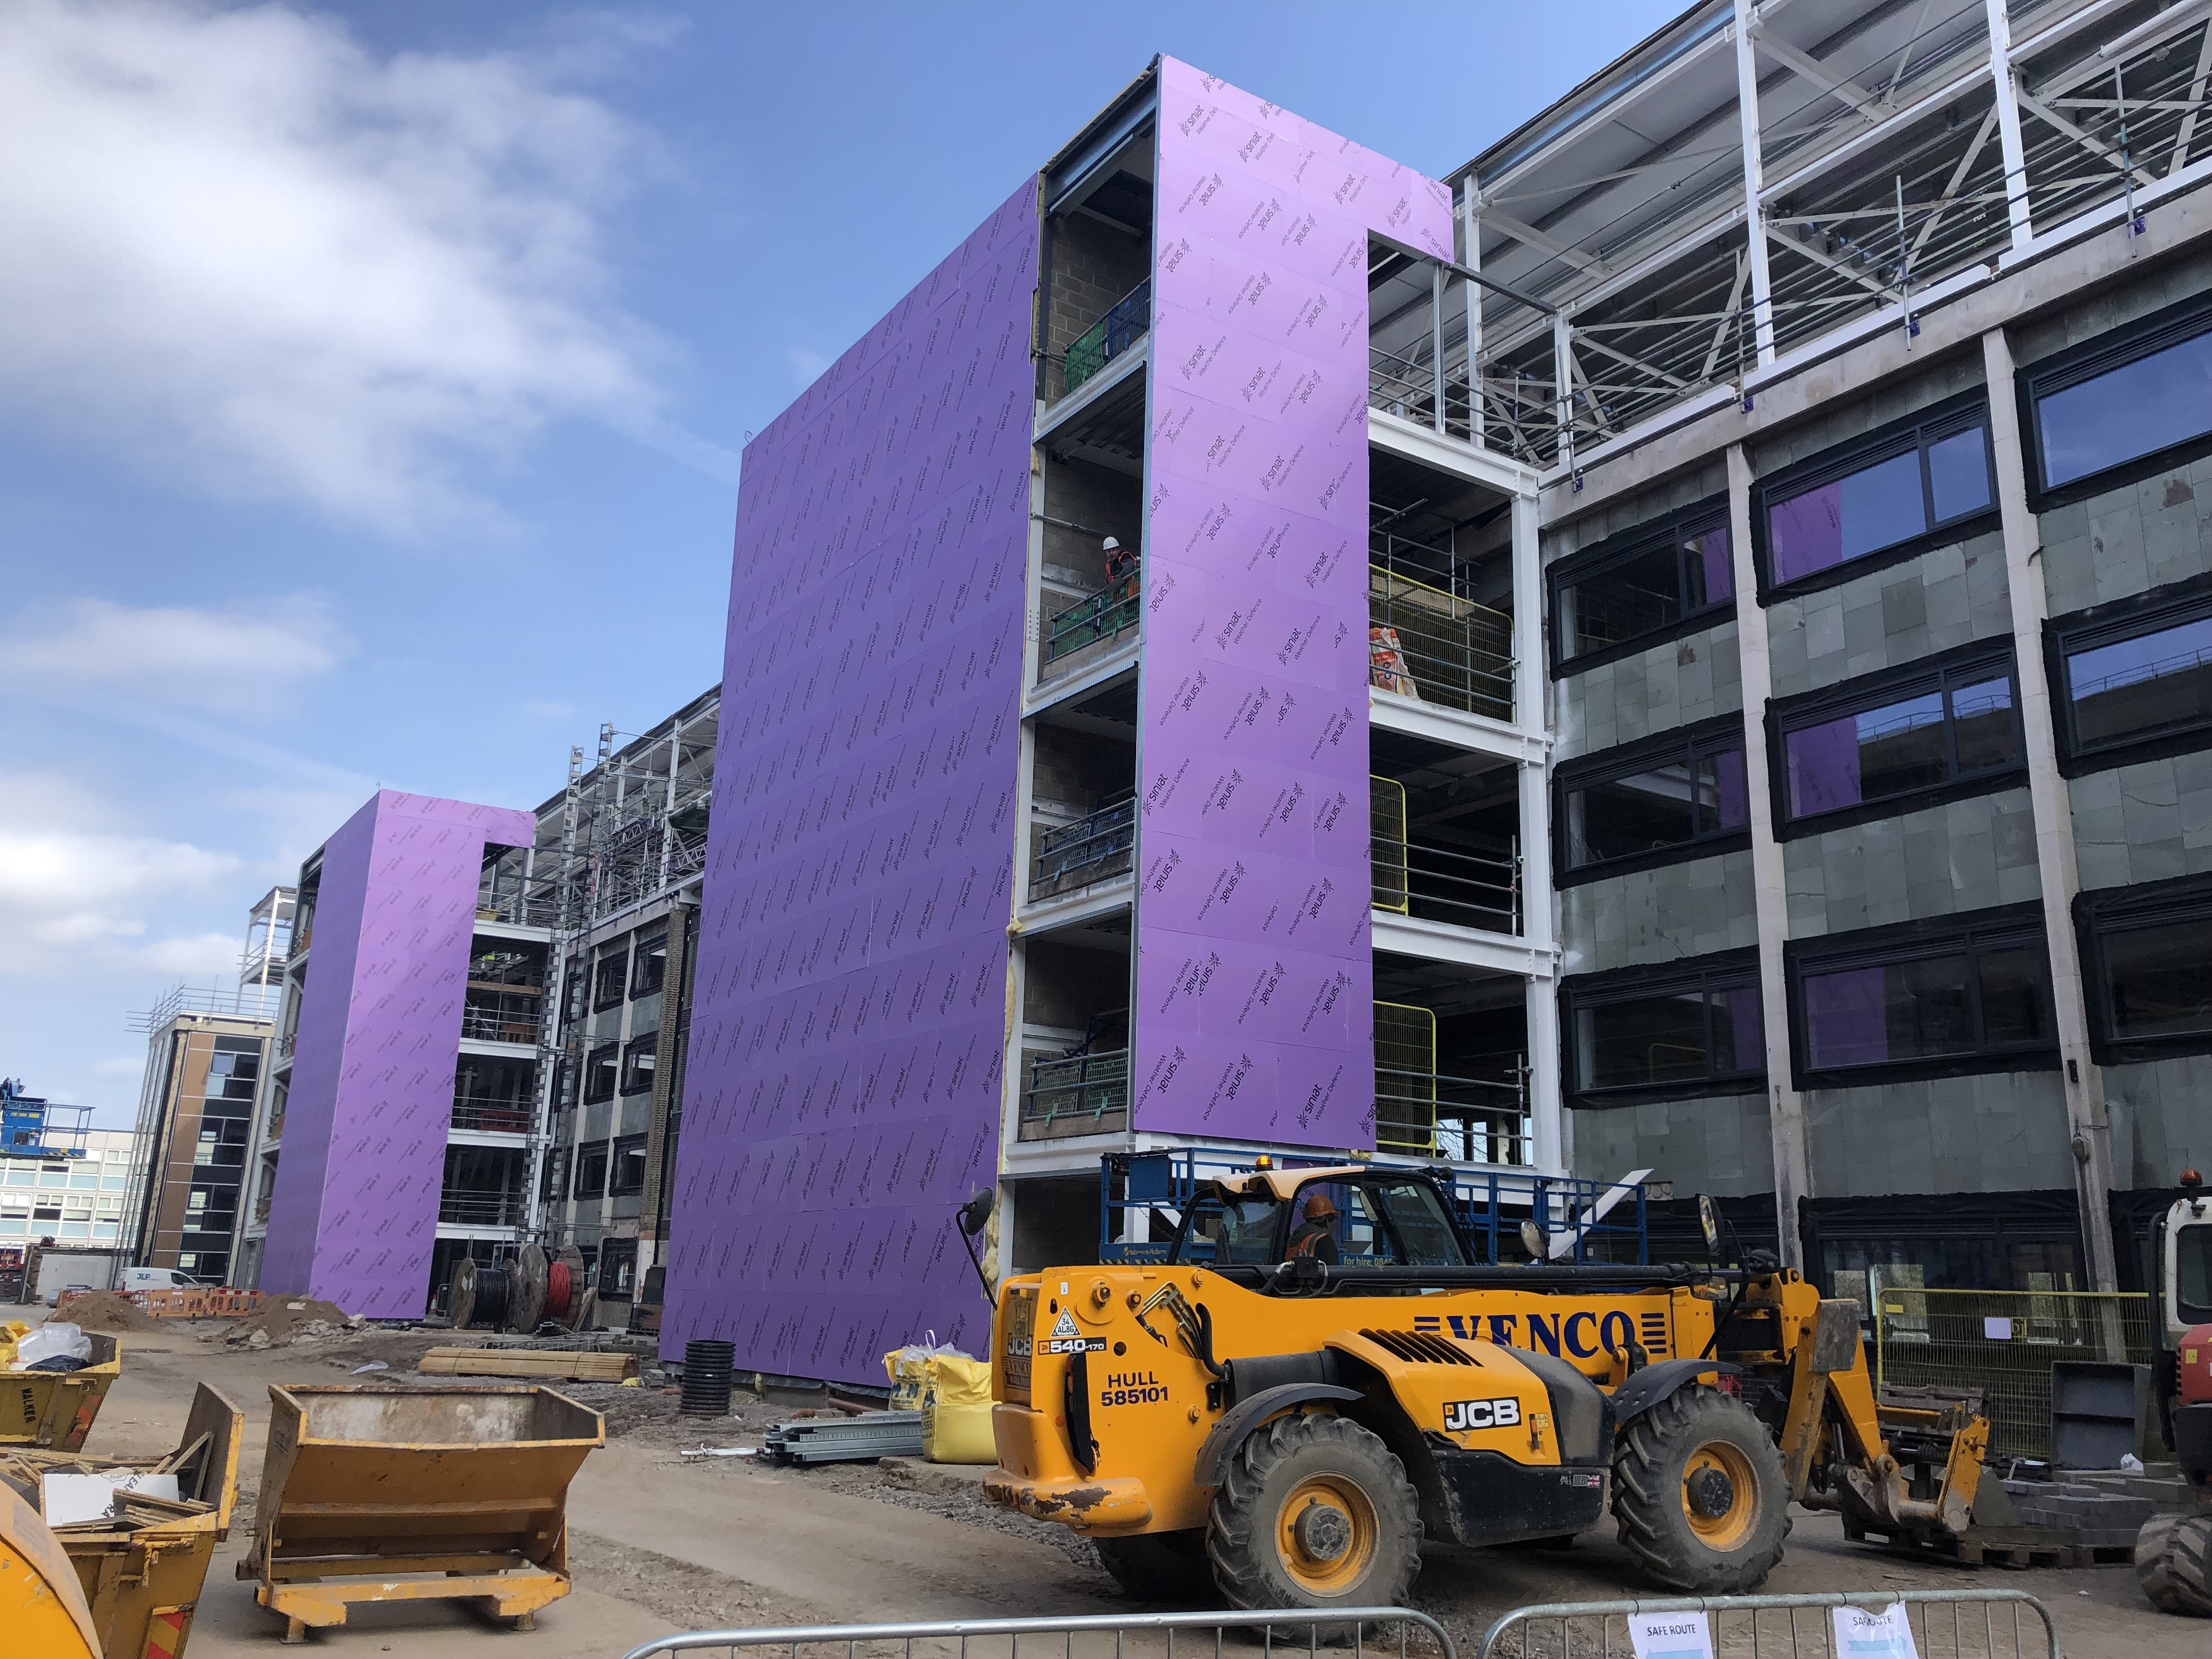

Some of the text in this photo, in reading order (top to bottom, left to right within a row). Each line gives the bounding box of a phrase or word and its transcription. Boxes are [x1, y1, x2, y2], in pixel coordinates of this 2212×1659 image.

[1196, 116, 1210, 134] Weather
[1255, 142, 1268, 160] Weather
[1178, 176, 1207, 214] Weather Defence
[1349, 184, 1362, 202] Weather
[1426, 186, 1444, 208] Weather
[1238, 201, 1265, 238] Weather Defence
[1288, 217, 1301, 234] Weather
[1159, 241, 1174, 262] Weather
[1331, 240, 1356, 276] Weather Defence
[1228, 275, 1255, 314] Weather Defence
[1286, 298, 1312, 336] Weather Defence
[1350, 310, 1364, 330] Defence
[1198, 335, 1227, 376] Weather Defence
[1258, 377, 1273, 398] Weather
[1280, 374, 1306, 414] Weather Defence
[1336, 394, 1362, 434] Weather Defence
[1217, 424, 1245, 467] Weather Defence
[1277, 445, 1304, 487] Weather Defence
[1186, 508, 1215, 552] Weather Defence
[1247, 527, 1275, 571] Weather Defence
[1321, 540, 1347, 584] Weather Defence
[1233, 599, 1261, 644] Weather Defence
[1294, 615, 1321, 661] Weather Defence
[1159, 677, 1190, 725] Weather Defence
[1223, 692, 1253, 740] Weather Defence
[1310, 713, 1338, 760] Weather Defence
[1159, 758, 1190, 809] Weather Defence
[1210, 775, 1225, 800] Weather
[1259, 788, 1288, 838] Weather Defence
[1317, 798, 1331, 823] Weather
[1146, 856, 1163, 883] Weather
[1197, 868, 1228, 921] Weather Defence
[1288, 884, 1316, 935] Weather Defence
[1160, 958, 1193, 1014] Weather Defence
[1238, 969, 1268, 1024] Weather Defence
[1301, 979, 1330, 1032] Weather Defence
[1134, 1054, 1167, 1114] Weather Defence
[1203, 1062, 1234, 1121] Weather Defence
[1314, 1064, 1343, 1120] Weather Defence
[1344, 1256, 1355, 1265] for
[1008, 1337, 1032, 1356] JCB
[1447, 1311, 1635, 1358] VENCO
[1101, 1386, 1168, 1407] 585101
[1108, 1371, 1159, 1388] HULL
[21, 1387, 36, 1423] WALKER
[1446, 1400, 1520, 1430] JCB
[1647, 1624, 1696, 1636] SAFE ROUTE
